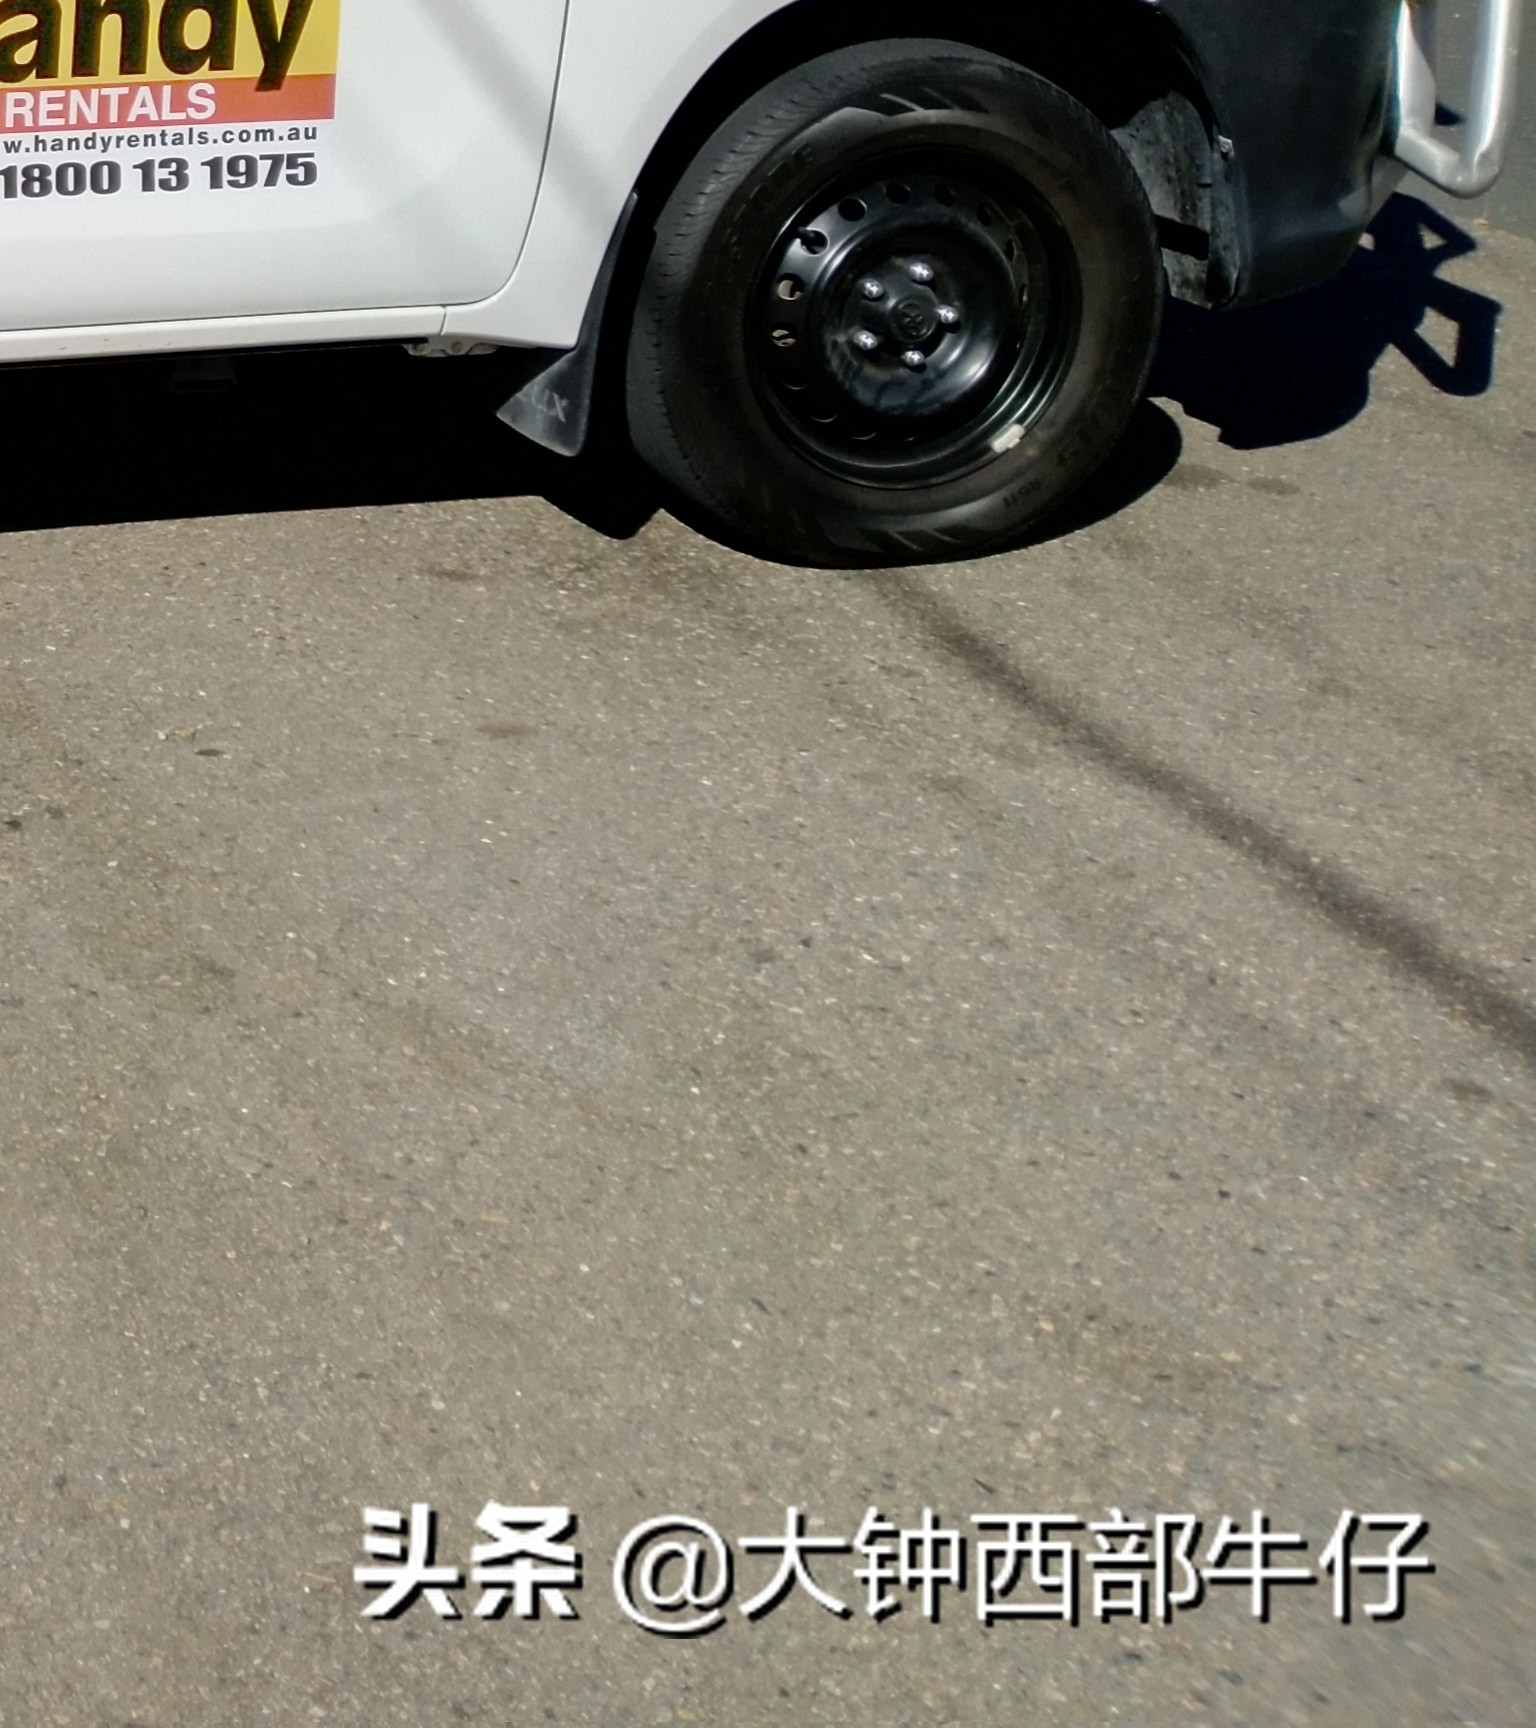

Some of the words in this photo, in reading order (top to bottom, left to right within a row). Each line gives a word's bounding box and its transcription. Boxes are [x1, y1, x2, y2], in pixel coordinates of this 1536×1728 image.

[3, 83, 216, 129] RENTALS
[131, 157, 190, 194] 13
[198, 152, 318, 191] 1975
